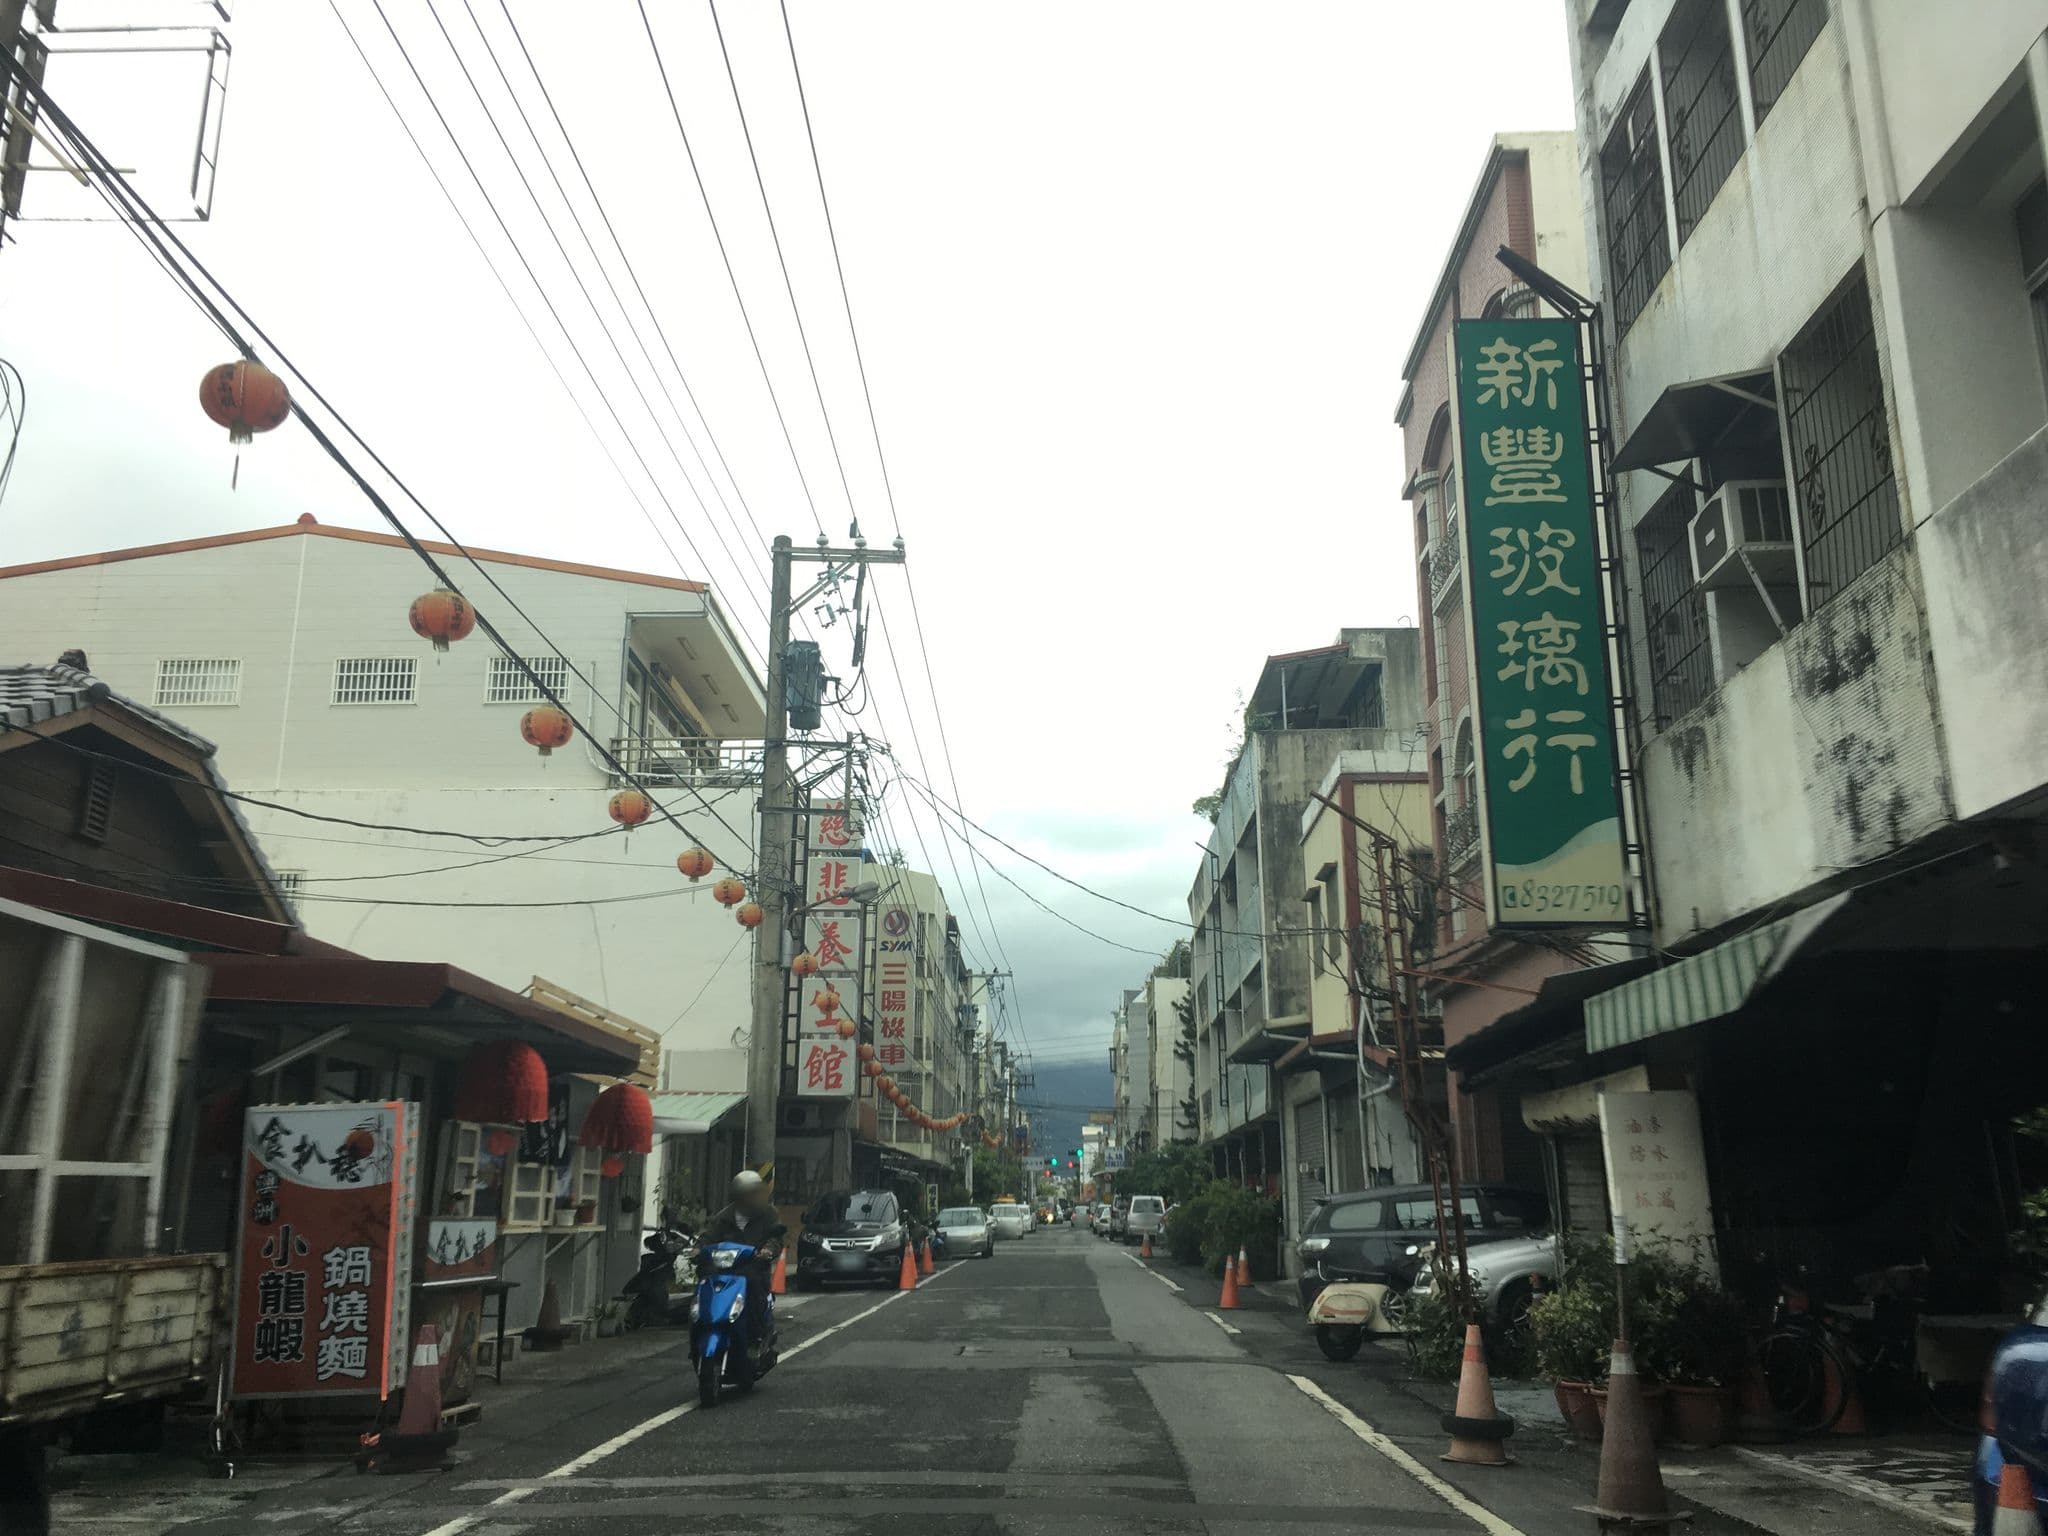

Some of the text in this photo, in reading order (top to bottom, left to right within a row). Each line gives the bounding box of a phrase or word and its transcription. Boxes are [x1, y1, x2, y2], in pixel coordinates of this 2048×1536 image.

[1477, 337, 1597, 794] 新豐玻璃行
[804, 802, 852, 1090] 慈悲養生館
[880, 940, 912, 952] SYM
[880, 962, 907, 1065] 三陽機車
[254, 1225, 309, 1363] 小龍蝦
[317, 1246, 371, 1381] 鍋燒麵
